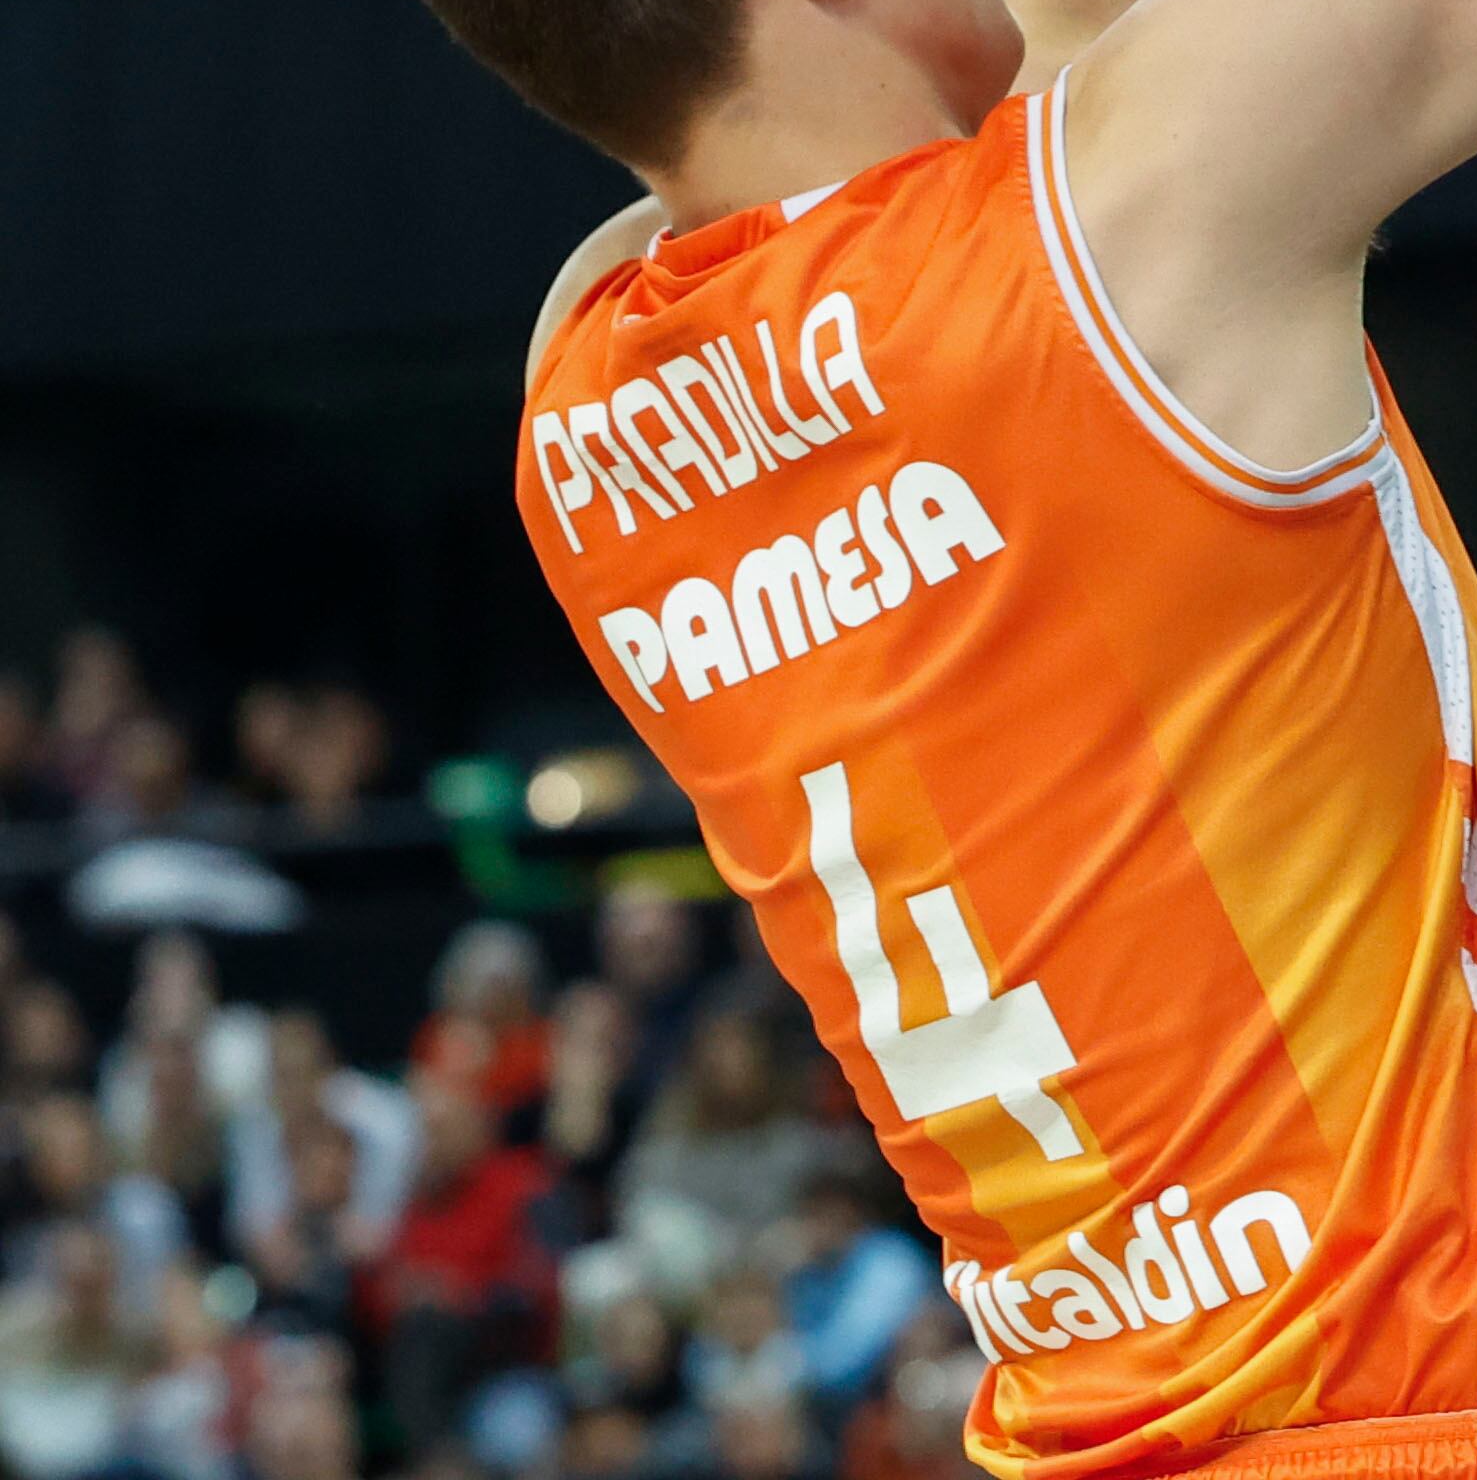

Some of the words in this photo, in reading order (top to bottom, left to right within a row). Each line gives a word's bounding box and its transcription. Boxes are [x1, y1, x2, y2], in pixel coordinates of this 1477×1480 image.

[533, 290, 886, 554] PRADILLA
[599, 461, 1005, 712] PAMESA
[801, 761, 1085, 1162] 4
